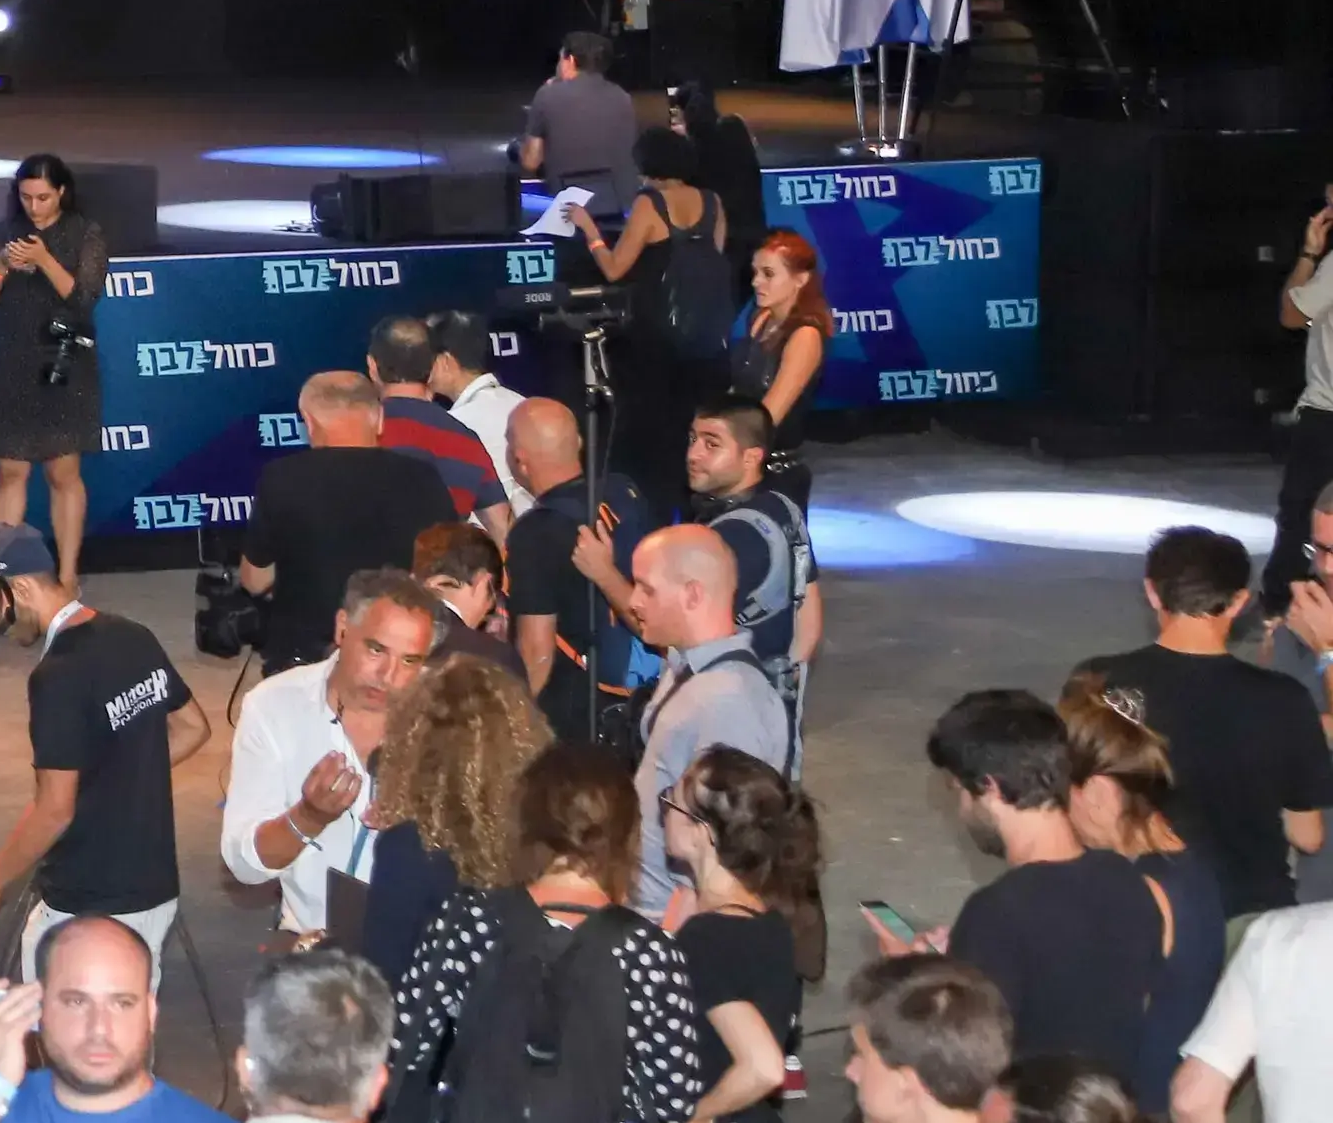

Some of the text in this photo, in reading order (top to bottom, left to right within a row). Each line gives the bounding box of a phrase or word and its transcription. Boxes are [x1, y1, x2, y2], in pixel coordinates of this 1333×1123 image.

[834, 173, 898, 199] כחול
[937, 235, 1001, 261] כחול
[105, 270, 155, 299] כחו
[329, 258, 401, 288] כחול
[832, 307, 894, 333] כחול
[204, 339, 277, 370] כחול
[935, 369, 999, 395] כחול
[101, 425, 151, 452] כחו
[260, 413, 309, 447] בן.
[199, 492, 252, 523] חול
